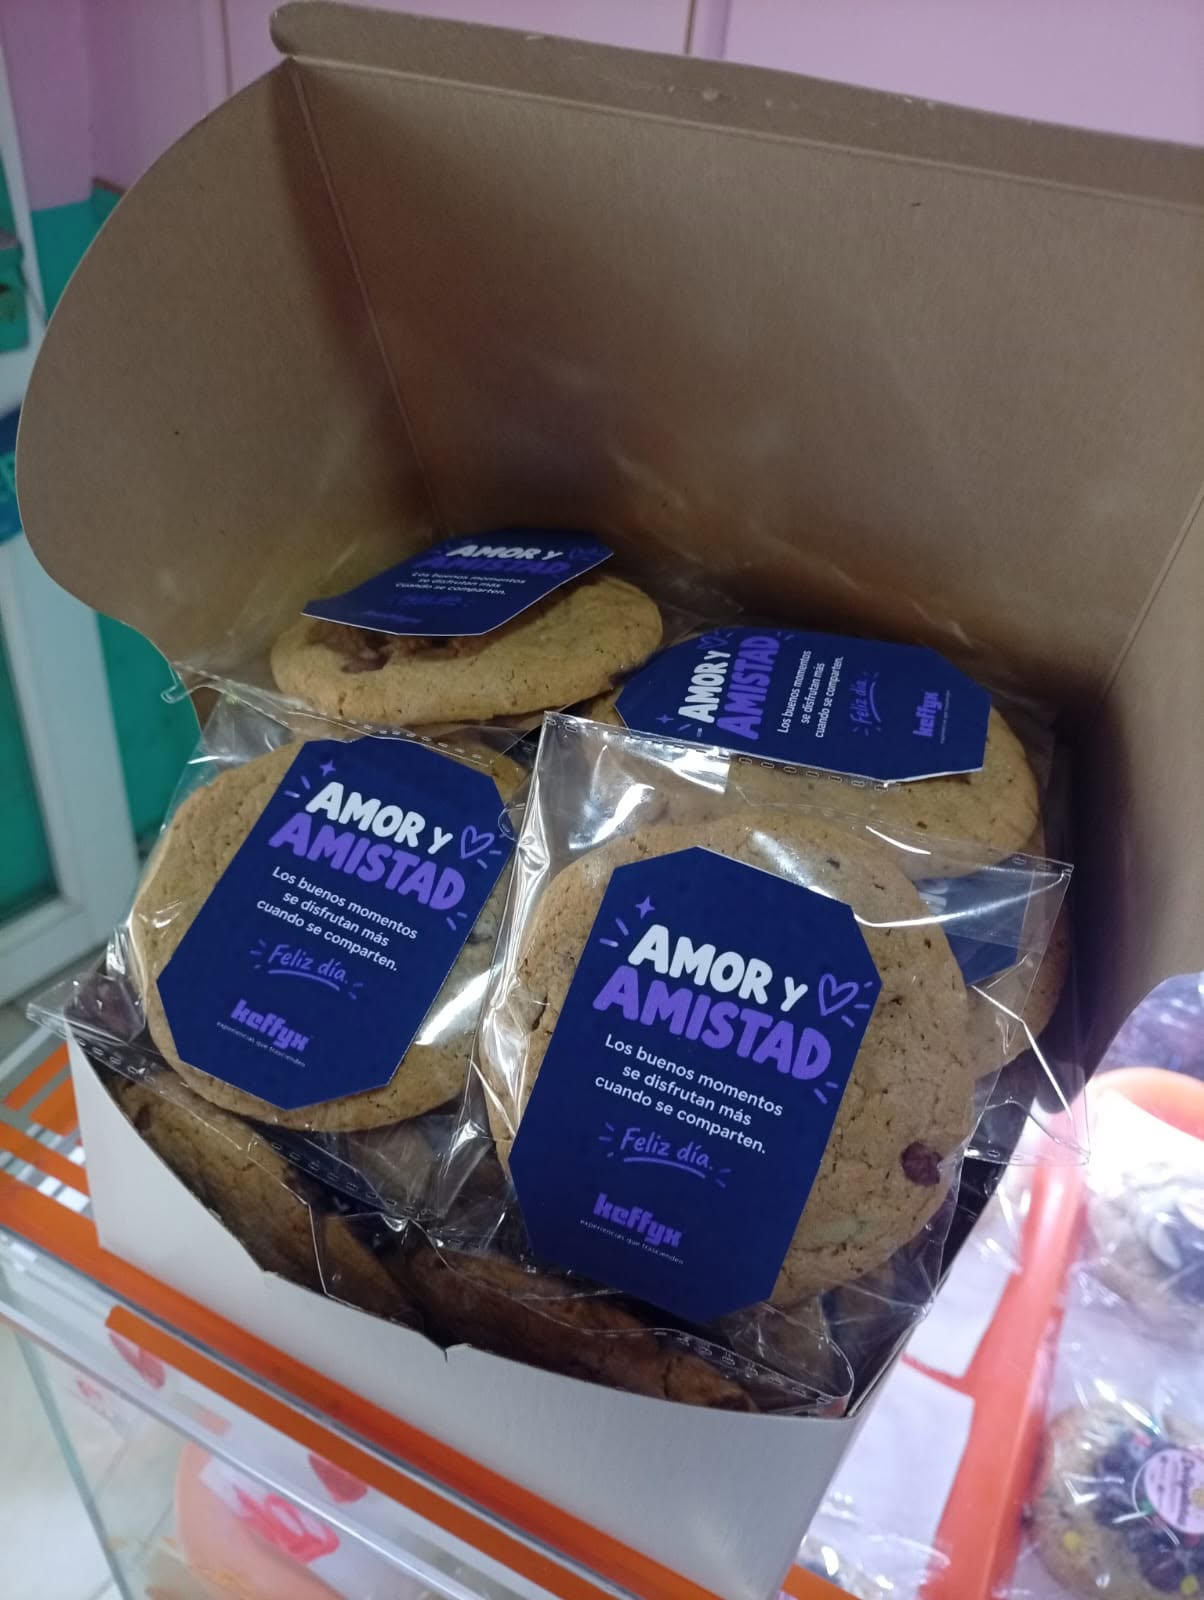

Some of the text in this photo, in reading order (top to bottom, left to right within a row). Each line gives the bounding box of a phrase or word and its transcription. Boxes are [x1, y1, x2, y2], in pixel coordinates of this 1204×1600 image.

[446, 545, 541, 559] AMOR
[678, 662, 728, 723] AMOR
[716, 635, 779, 740] AMISTAD
[777, 650, 812, 733] Los buenos momentos
[801, 662, 825, 724] se disfrutan más
[815, 656, 844, 738] cuando se comparten.
[305, 781, 426, 848] AMOR
[268, 812, 466, 911] AMISTAD
[256, 900, 398, 972] cuando se comparten.
[272, 865, 418, 940] Los buenos momentos
[282, 892, 390, 949] se disfrutan más
[268, 944, 314, 970] Feliz
[627, 924, 773, 1005] AMOR
[592, 964, 832, 1081] AMISTAD
[605, 1033, 784, 1116] Los buenos momentos
[622, 1065, 752, 1126] se disfrutan más
[595, 1076, 766, 1154] cuando se comparten.
[620, 1128, 671, 1156] Feliz
